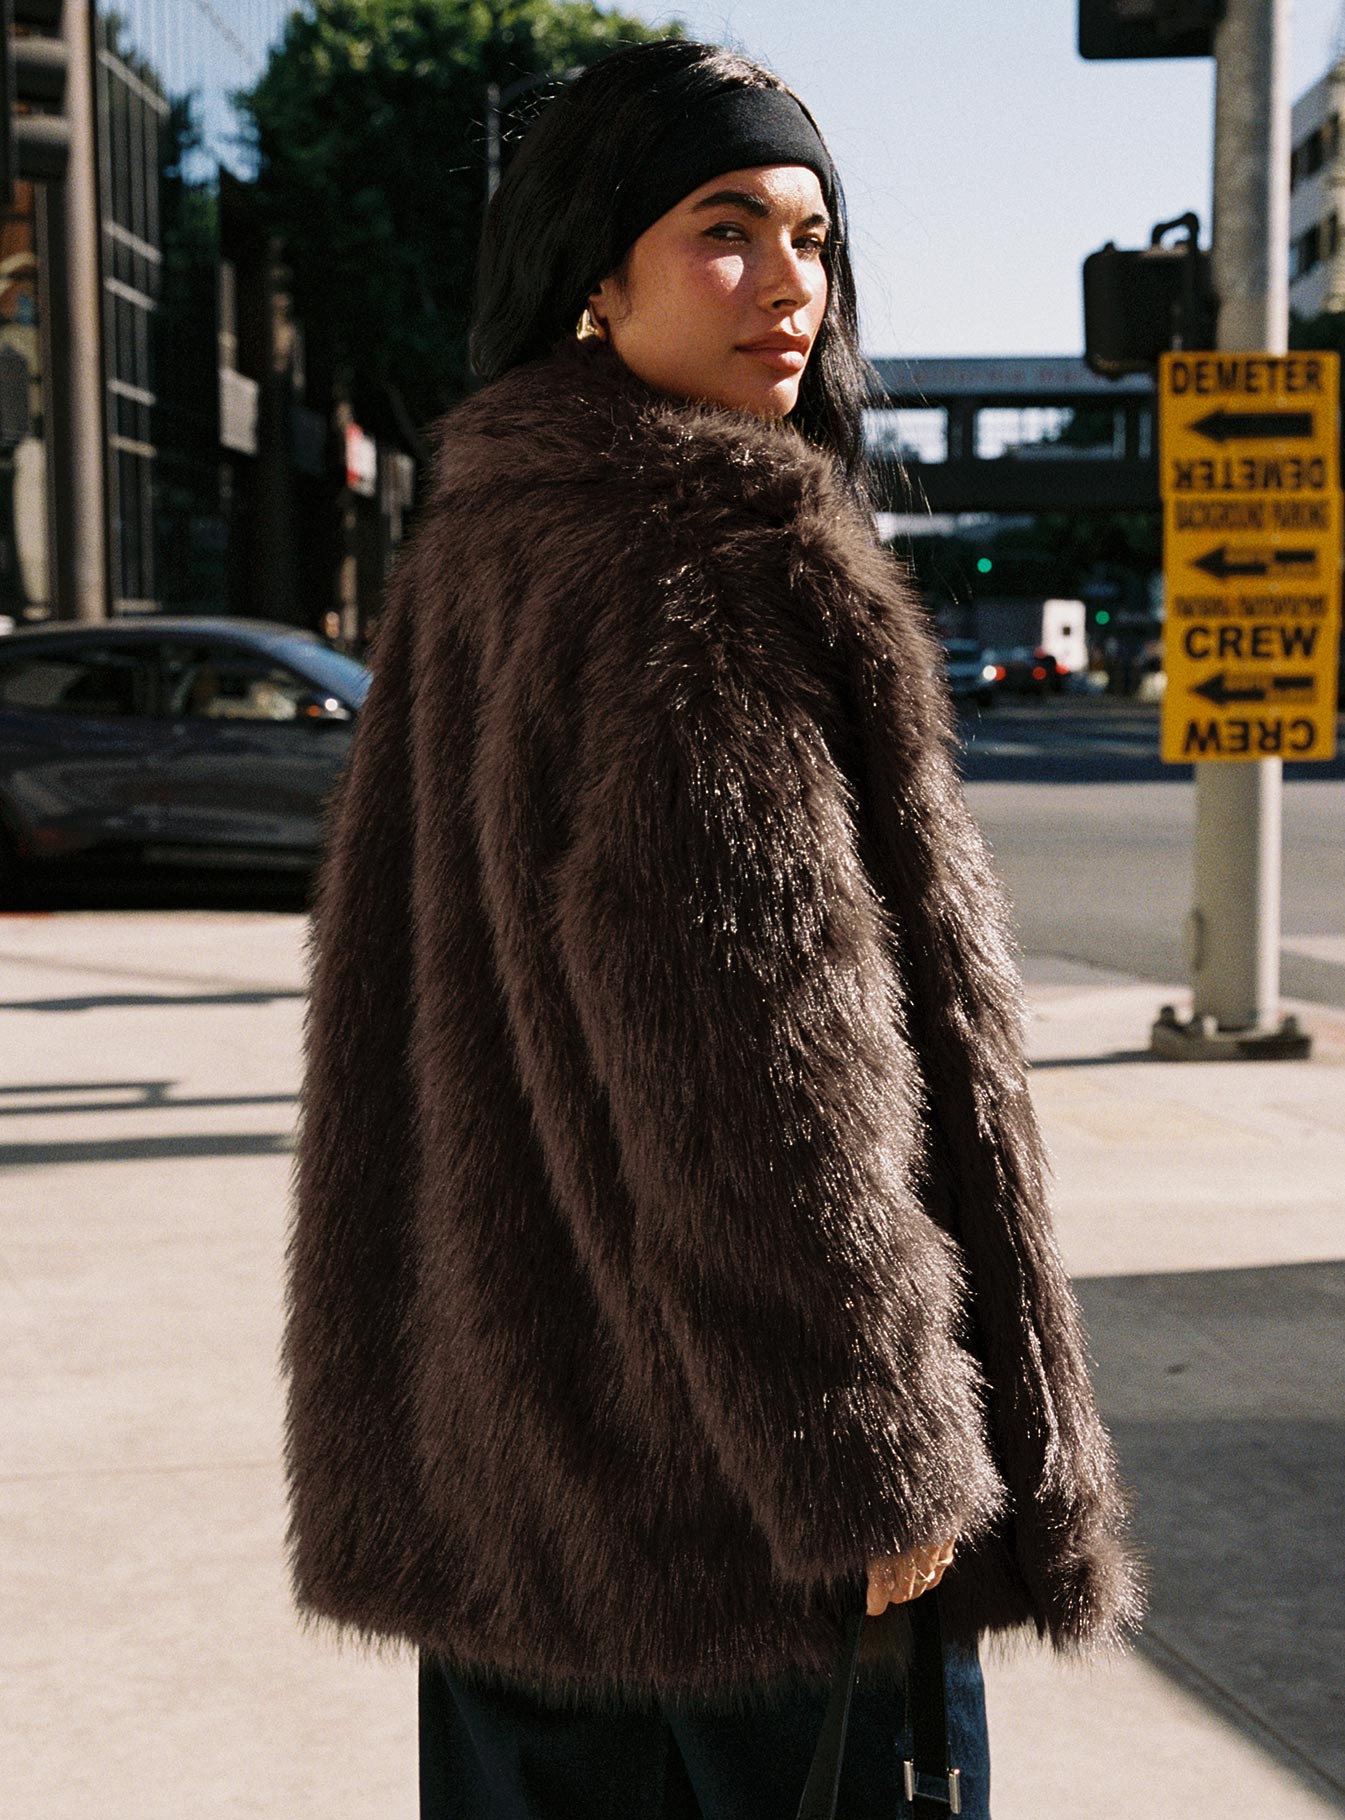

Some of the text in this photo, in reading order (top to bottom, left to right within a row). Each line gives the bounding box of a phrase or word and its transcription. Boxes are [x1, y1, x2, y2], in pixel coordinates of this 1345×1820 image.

[1171, 361, 1322, 394] DEMETER
[1185, 626, 1316, 659] CREW
[1185, 719, 1315, 754] CREW
